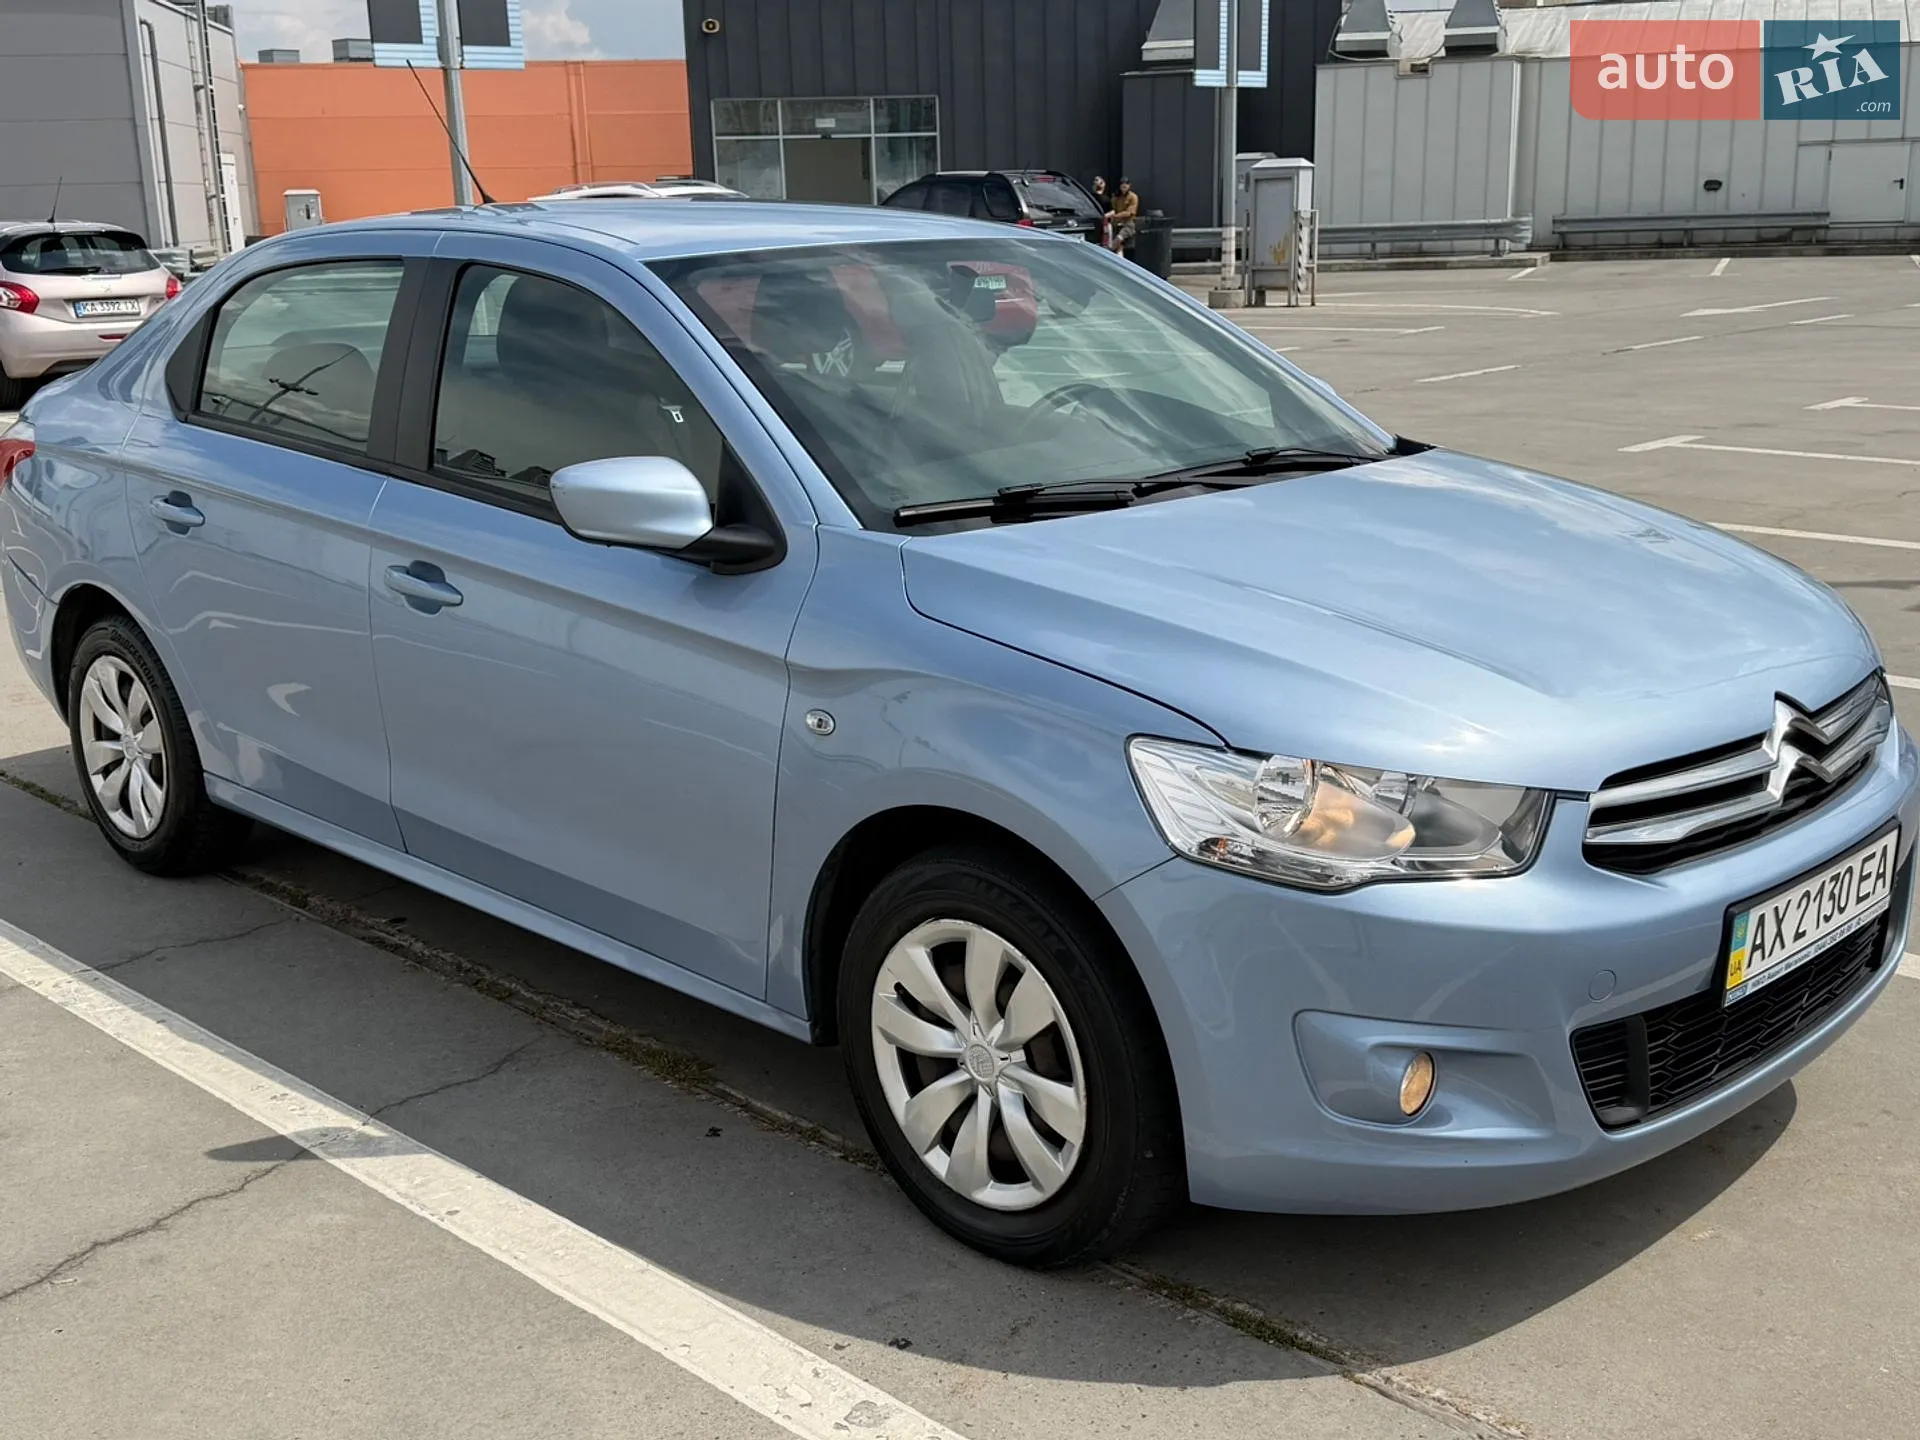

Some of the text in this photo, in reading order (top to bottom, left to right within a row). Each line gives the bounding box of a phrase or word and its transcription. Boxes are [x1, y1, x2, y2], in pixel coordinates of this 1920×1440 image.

[82, 301, 98, 312] KA
[1747, 899, 1791, 968] AX
[1793, 865, 1853, 943] 2130
[1855, 844, 1888, 906] EA
[1730, 959, 1742, 977] UA
